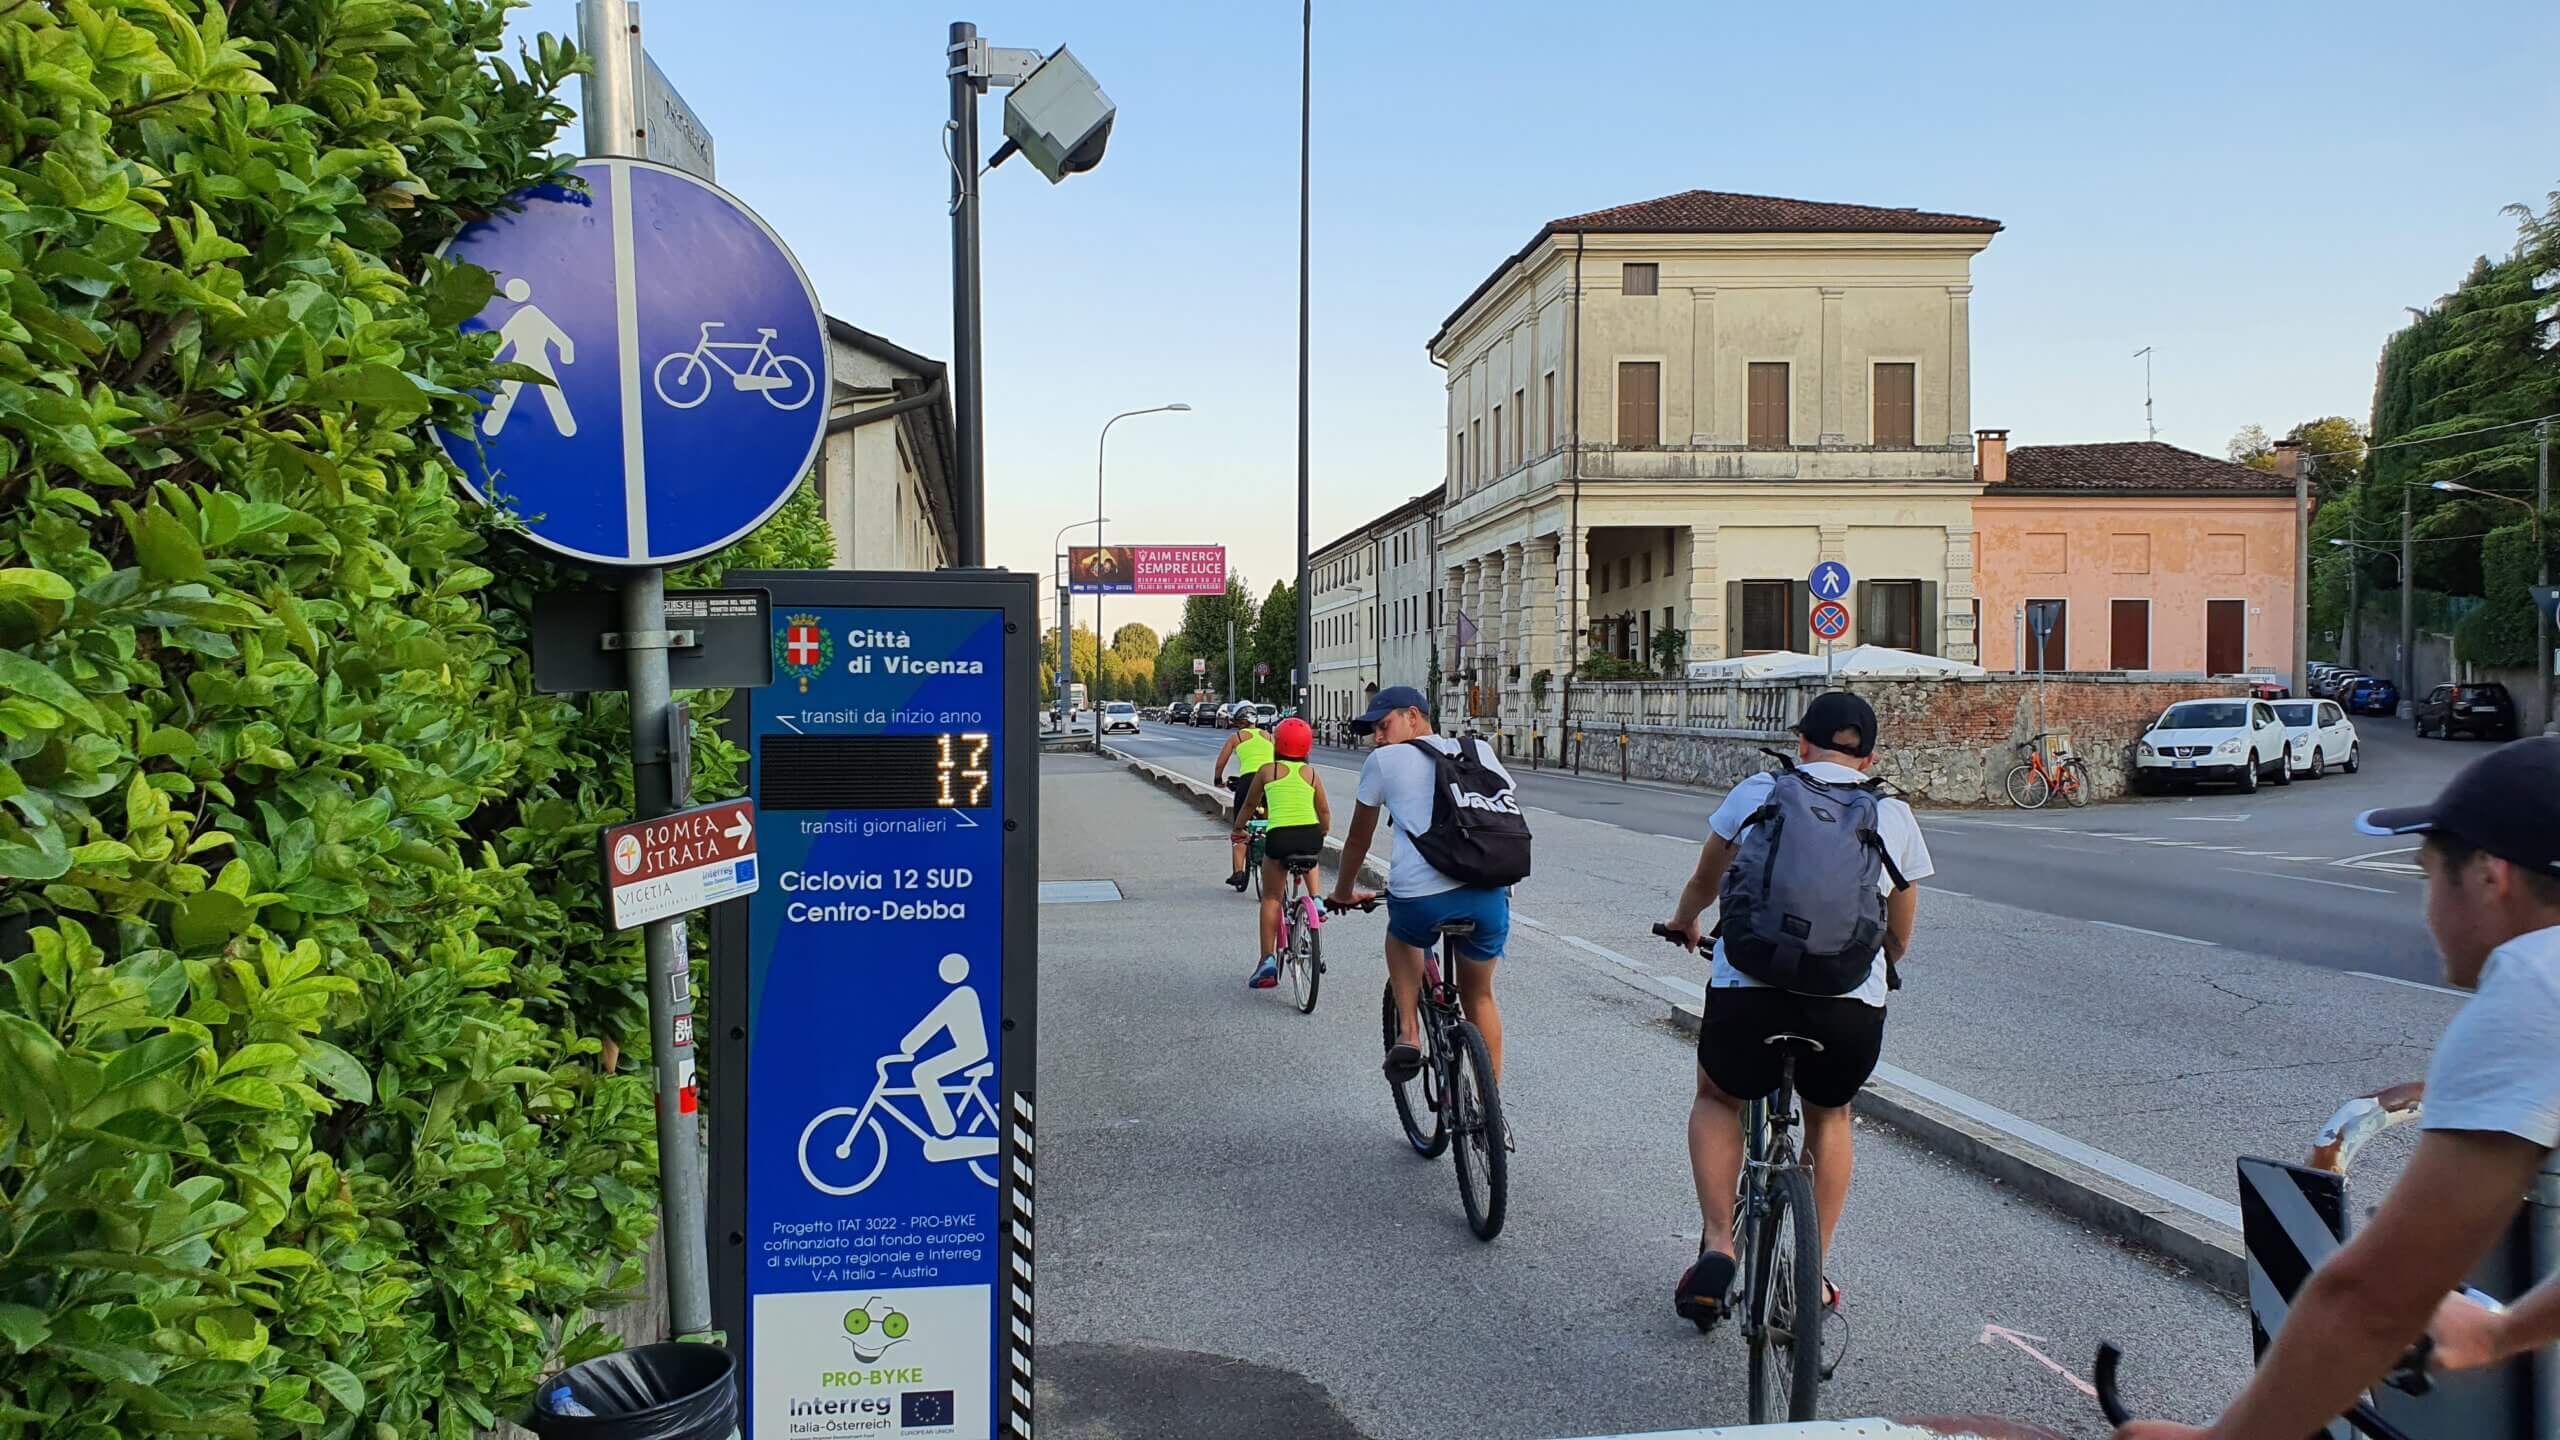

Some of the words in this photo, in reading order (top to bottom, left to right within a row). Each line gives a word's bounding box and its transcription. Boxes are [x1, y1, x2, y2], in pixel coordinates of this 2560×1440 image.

[1149, 551, 1172, 561] AIM
[1176, 551, 1222, 561] ENERGY
[1138, 563, 1189, 574] SEMPRE
[1191, 563, 1222, 574] LUCE
[848, 629, 911, 648] Città
[848, 655, 872, 674] di
[884, 655, 984, 674] Vicenza
[801, 709, 859, 724] transiti
[864, 709, 886, 724] da
[891, 709, 935, 724] inizio
[939, 711, 982, 723] anno
[937, 733, 989, 768] 17
[937, 770, 988, 805] 17
[1449, 783, 1521, 815] VANS
[646, 816, 720, 848] ROMEA
[800, 818, 858, 834] transiti
[863, 816, 947, 837] giornalieri
[646, 838, 720, 873] STRATA
[779, 870, 882, 892] Ciclovia
[893, 869, 919, 889] 12
[926, 868, 973, 889] SUD
[617, 881, 673, 906] VICETIA
[787, 900, 966, 923] Centro-Debba
[773, 1220, 833, 1237] Progetto
[837, 1218, 862, 1232] ITAT
[865, 1217, 897, 1231] 3022
[911, 1214, 977, 1229] PRO-BYKE
[763, 1236, 850, 1252] cofinanziato
[854, 1235, 877, 1249] dal
[880, 1233, 922, 1247] fondo
[926, 1232, 985, 1247] europeo
[767, 1254, 780, 1268] di
[784, 1253, 841, 1270] sviluppo
[845, 1250, 911, 1267] regionale
[915, 1252, 925, 1261] e
[928, 1247, 982, 1262] Interreg
[811, 1270, 838, 1282] V-A
[842, 1267, 876, 1281] Italia
[892, 1265, 938, 1279] Austria
[822, 1368, 923, 1387] PRO-BYKE
[790, 1396, 892, 1417] Interreg
[790, 1418, 892, 1434] Italia-Österreich
